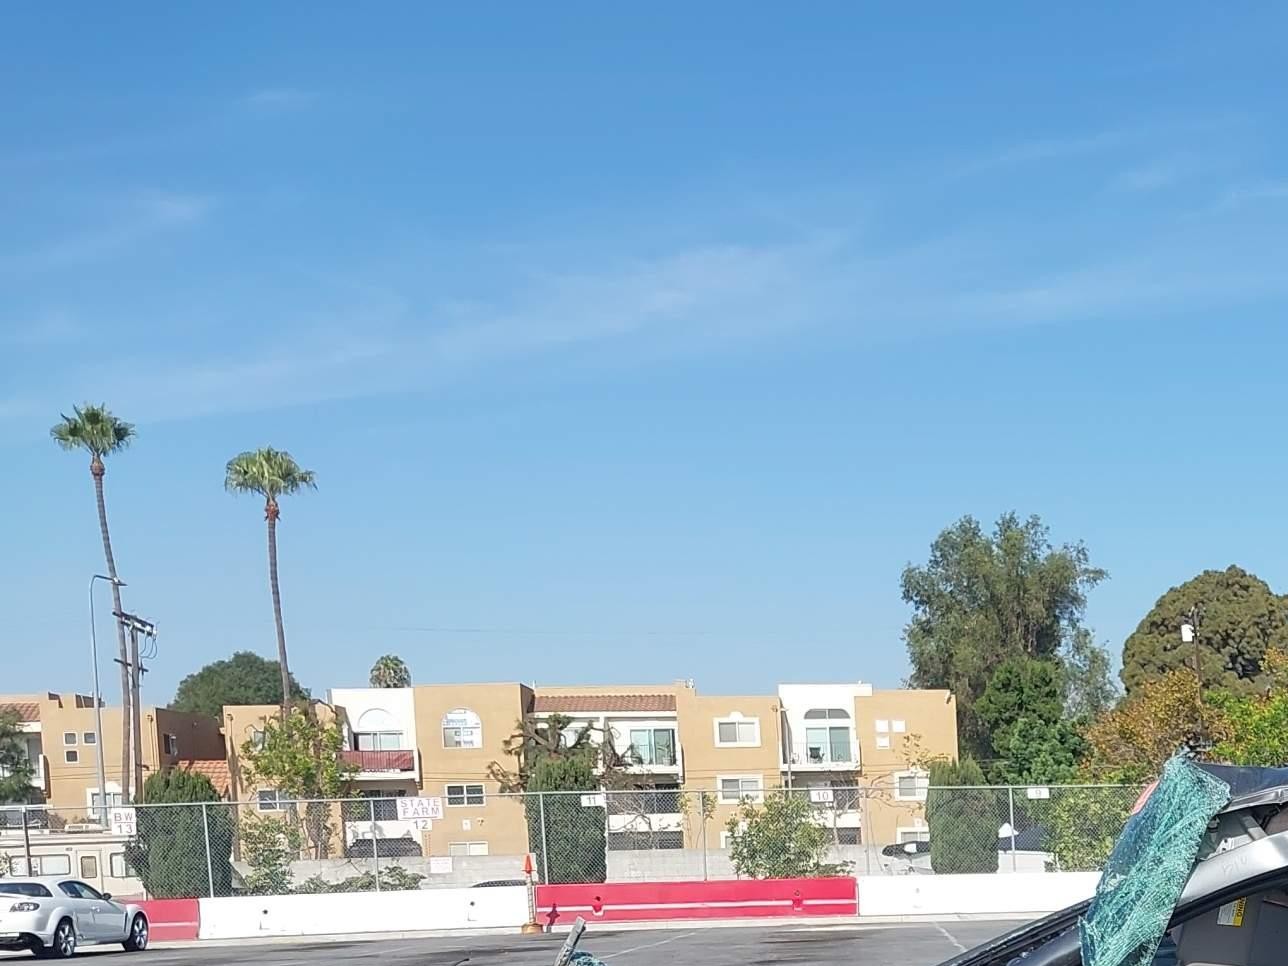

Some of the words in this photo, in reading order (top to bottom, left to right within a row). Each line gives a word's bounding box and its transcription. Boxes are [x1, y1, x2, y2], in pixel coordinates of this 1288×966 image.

[587, 796, 596, 805] 11
[816, 791, 829, 801] 10
[401, 799, 440, 808] STATE
[114, 812, 133, 822] BW
[403, 808, 440, 817] FARM
[116, 823, 133, 834] 13
[413, 819, 429, 830] 12
